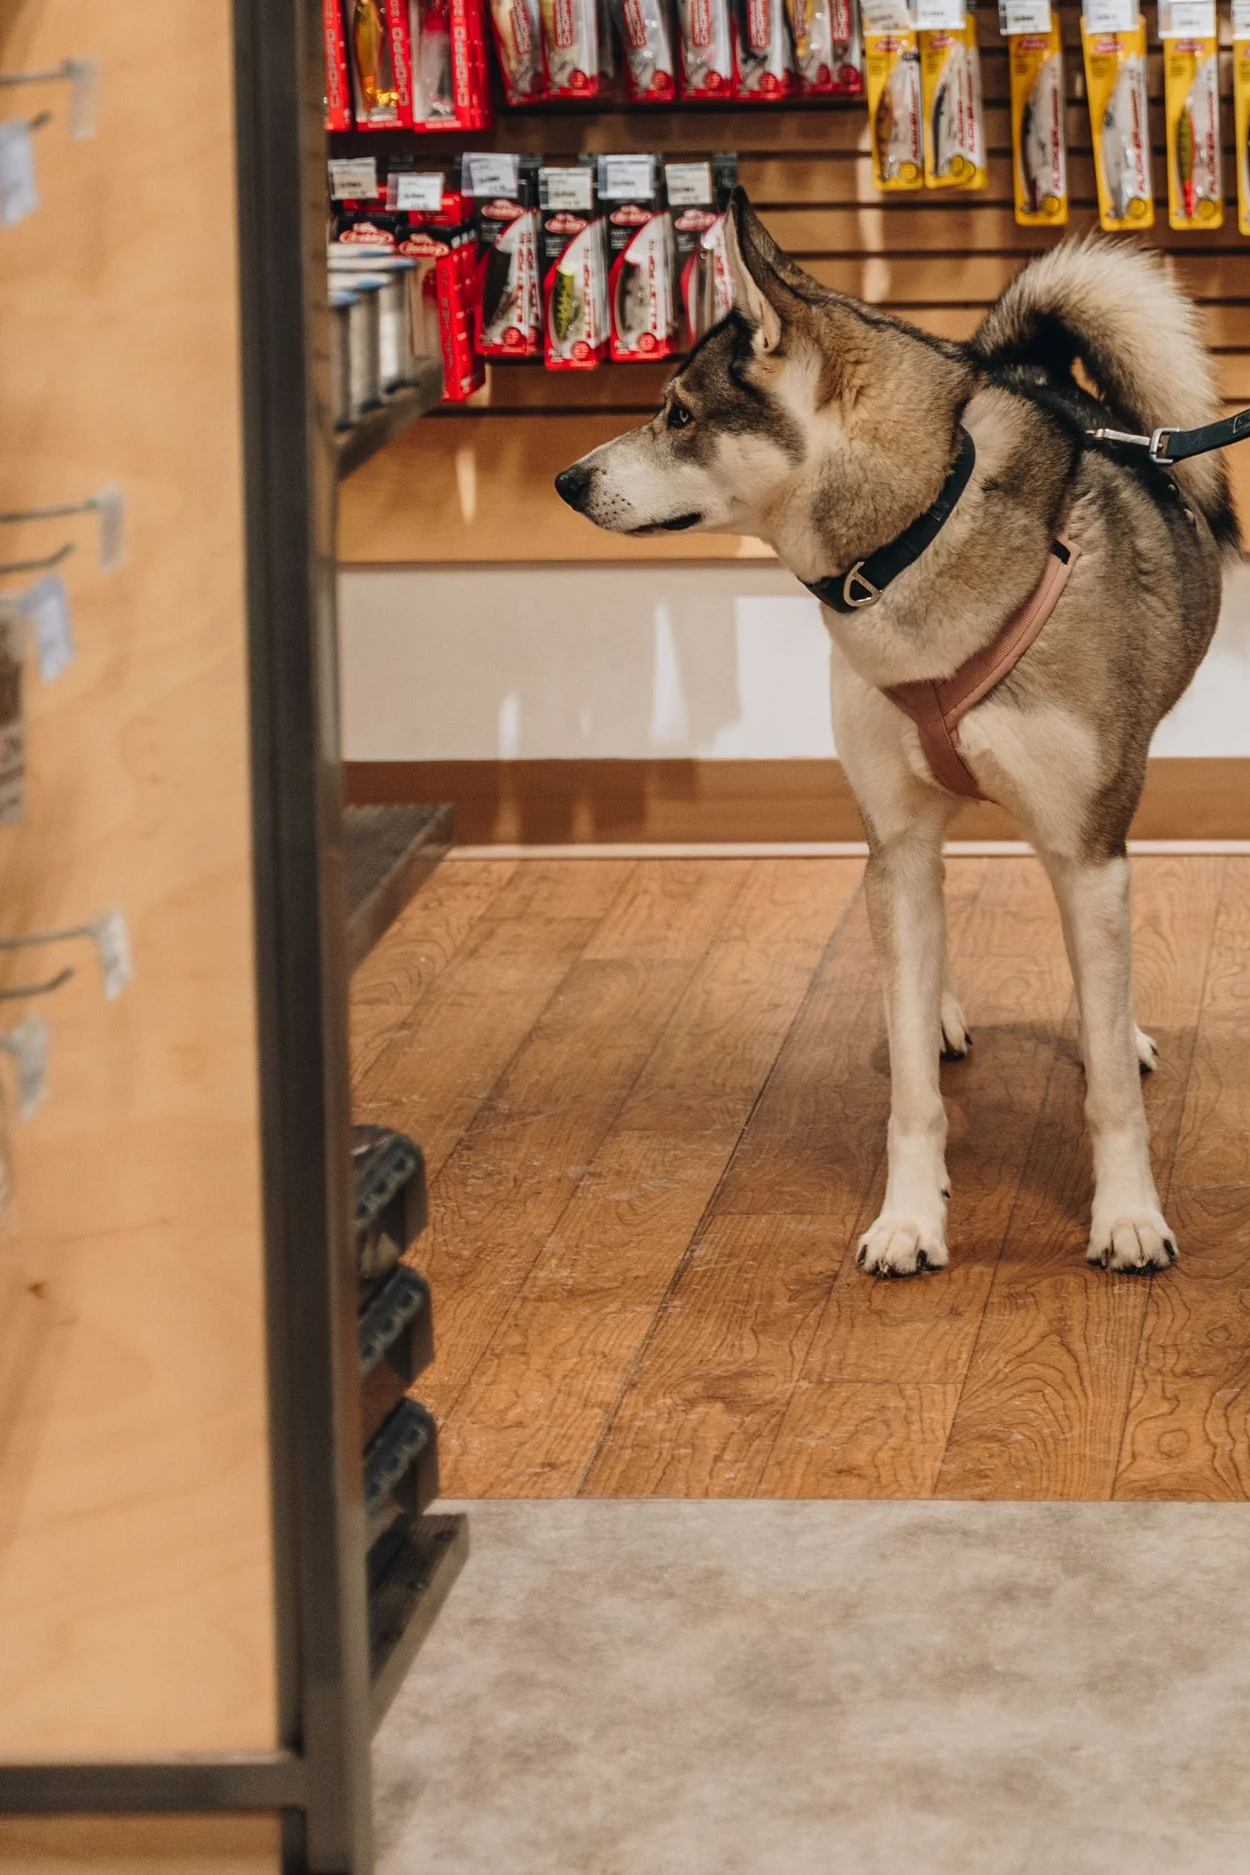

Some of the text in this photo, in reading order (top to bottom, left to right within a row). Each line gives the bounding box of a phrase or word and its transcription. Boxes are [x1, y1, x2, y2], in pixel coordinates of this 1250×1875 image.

[326, 28, 341, 108] CHOPPO
[392, 27, 410, 106] CHOPPO
[454, 27, 469, 107] CHOPPO
